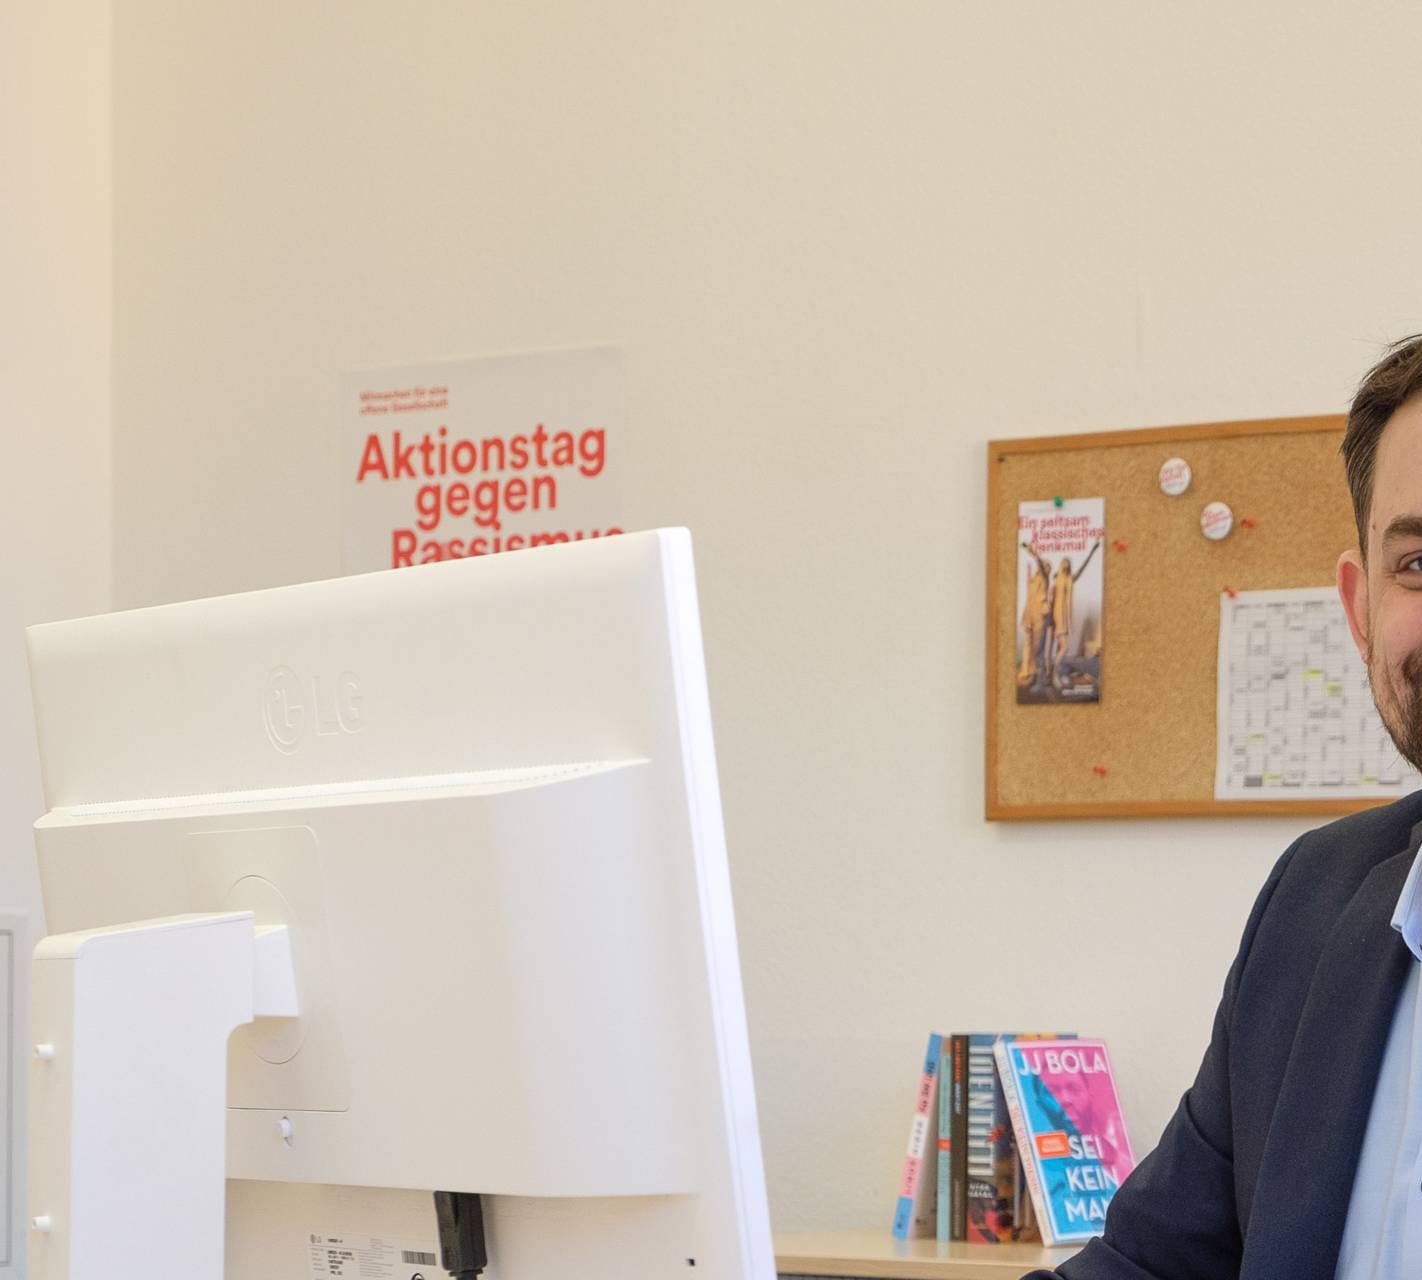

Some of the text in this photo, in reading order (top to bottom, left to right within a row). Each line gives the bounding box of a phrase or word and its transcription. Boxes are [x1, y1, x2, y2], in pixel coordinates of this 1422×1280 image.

[356, 424, 606, 483] Aktionstag
[415, 474, 557, 531] gegen
[391, 523, 625, 569] Rassi
[1033, 541, 1086, 552] enkmal
[310, 672, 363, 736] LG
[1018, 1050, 1109, 1076] JJ BOLA
[1067, 1134, 1106, 1160] SEI
[1064, 1163, 1120, 1192] KEIN
[1063, 1196, 1109, 1223] MA
